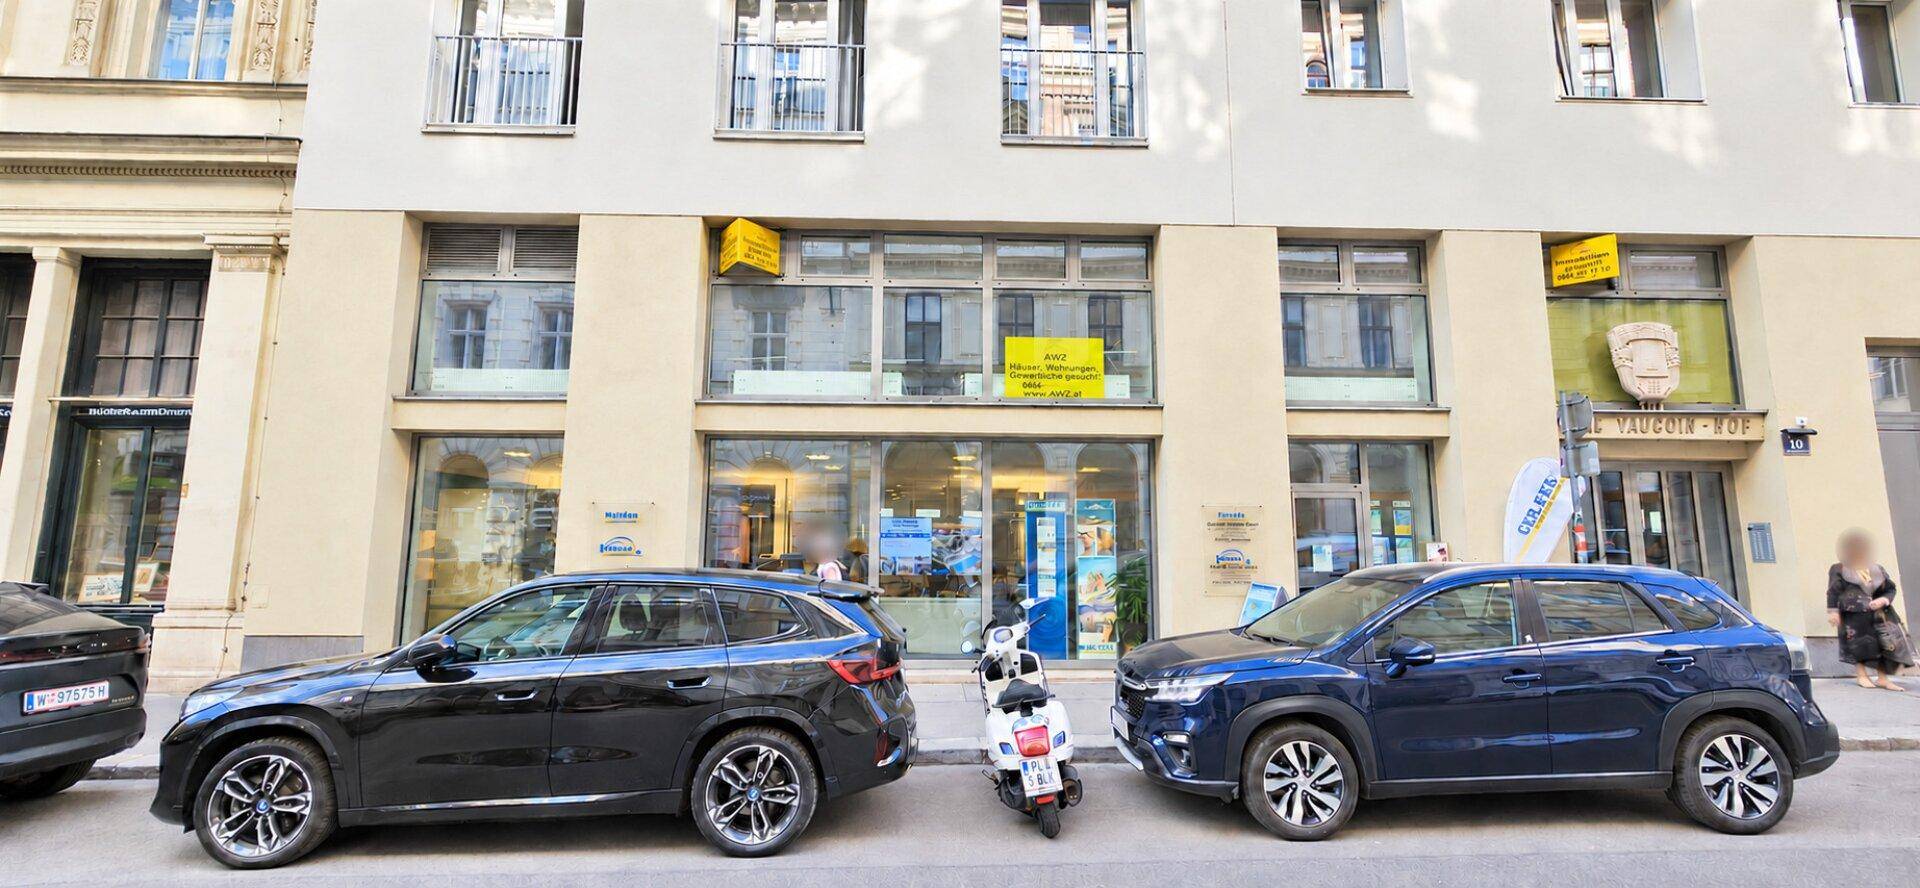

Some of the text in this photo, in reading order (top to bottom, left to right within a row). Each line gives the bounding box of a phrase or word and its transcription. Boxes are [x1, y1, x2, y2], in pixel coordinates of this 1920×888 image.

[1714, 417, 1751, 435] HOF
[1790, 439, 1803, 449] 10
[37, 693, 46, 706] W
[98, 685, 105, 698] H
